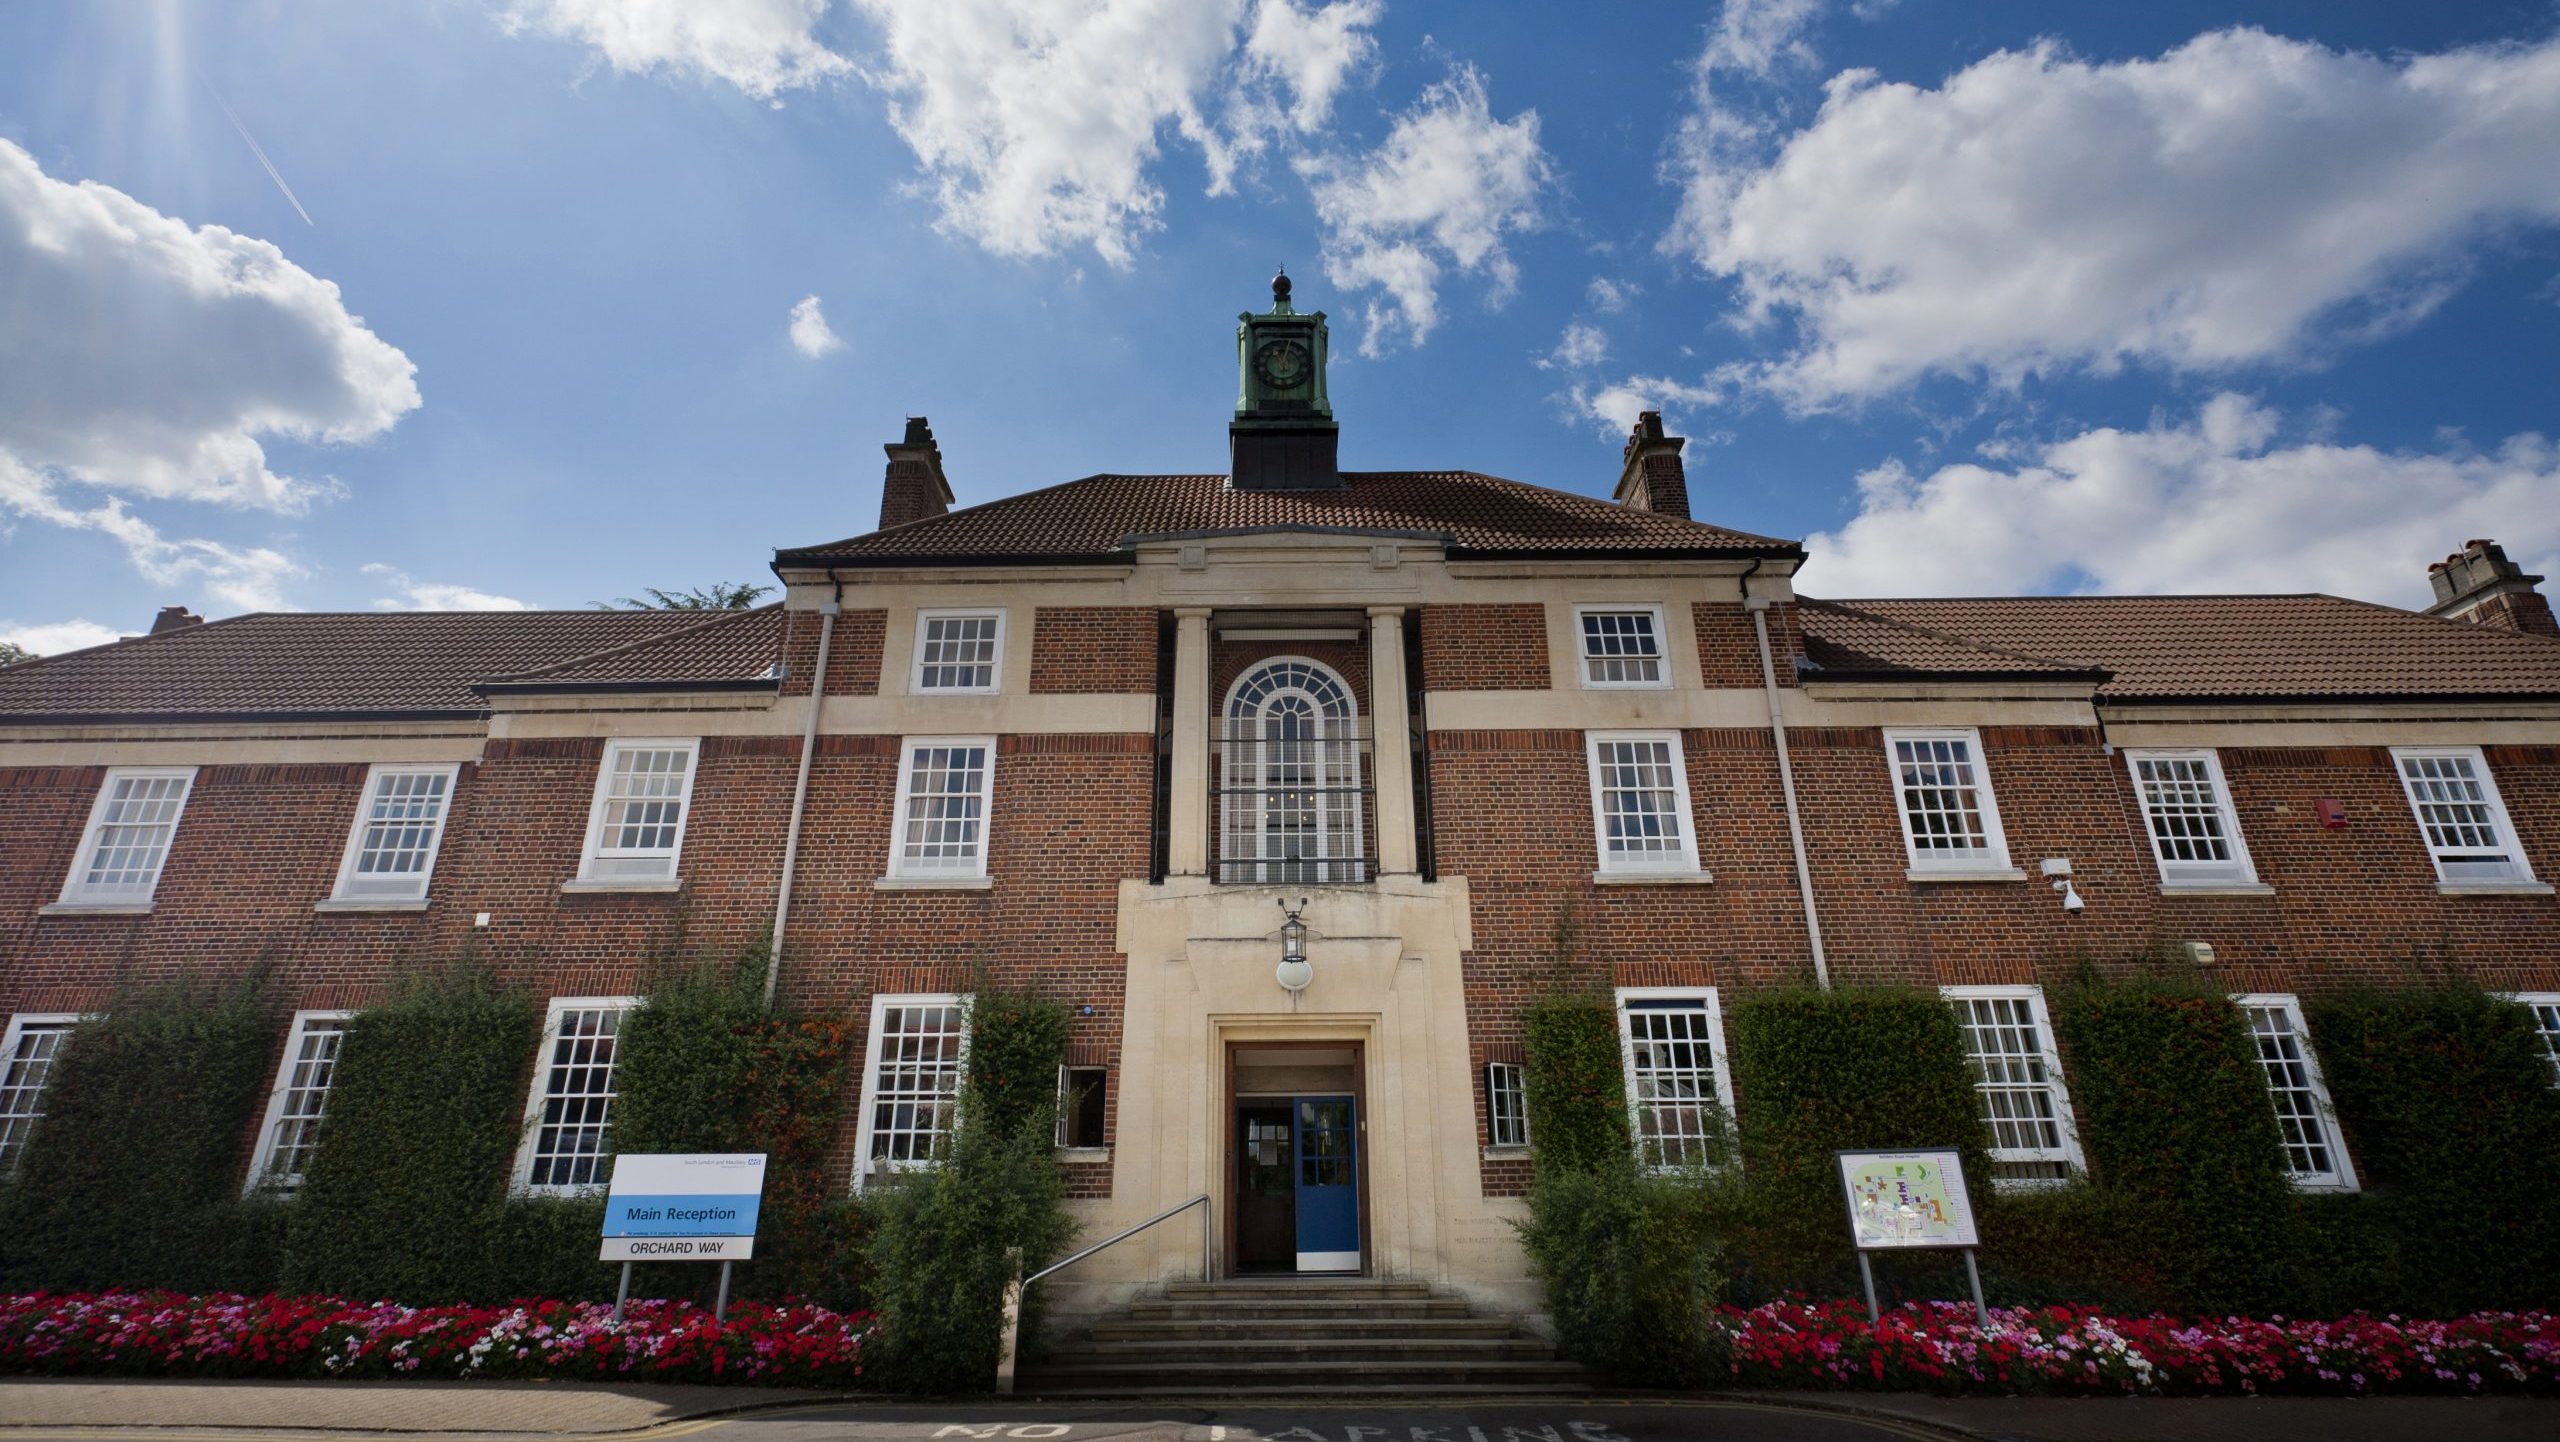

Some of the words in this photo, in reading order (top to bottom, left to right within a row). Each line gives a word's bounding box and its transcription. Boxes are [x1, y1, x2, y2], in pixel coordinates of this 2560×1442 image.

[627, 1208, 661, 1220] Main
[667, 1207, 736, 1222] Reception
[630, 1242, 693, 1255] ORCHARD
[699, 1242, 725, 1254] WAY
[931, 1424, 1073, 1439] NO
